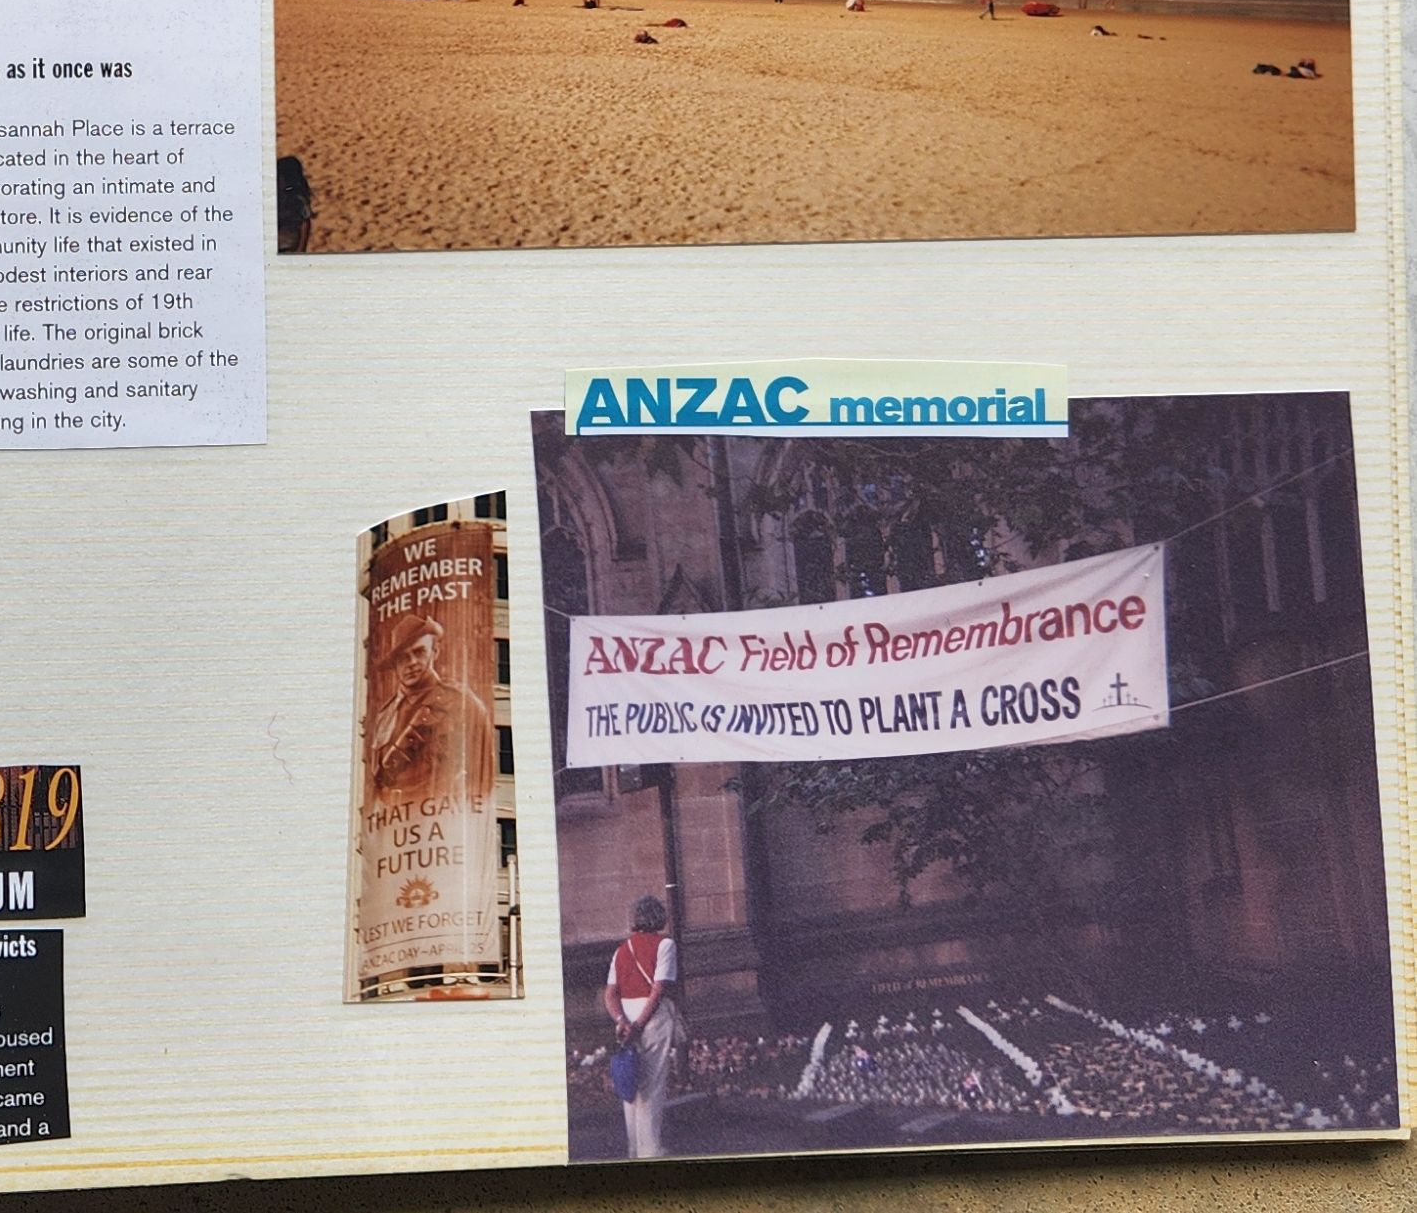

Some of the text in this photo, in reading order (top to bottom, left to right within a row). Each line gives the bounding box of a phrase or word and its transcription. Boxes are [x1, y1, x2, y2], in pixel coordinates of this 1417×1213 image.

[7, 64, 25, 78] as
[33, 58, 45, 78] it
[53, 63, 93, 78] once
[101, 63, 132, 77] was
[73, 119, 123, 136] Place
[132, 119, 145, 135] is
[152, 124, 163, 135] a
[170, 120, 235, 135] terrace
[54, 149, 69, 166] in
[76, 149, 105, 166] the
[113, 148, 159, 165] heart
[167, 148, 184, 164] of
[578, 376, 1045, 424] ANZAC memorial
[404, 538, 436, 563] WE
[371, 558, 482, 605] REMEMBER
[377, 581, 472, 622] THE PAST
[584, 595, 1146, 675] ANZAC Field of Remembrance
[586, 703, 621, 737] THE
[626, 702, 698, 734] PUBLIC
[726, 701, 819, 736] INVITED
[820, 699, 852, 735] TO
[859, 691, 942, 733] PLANT
[950, 689, 971, 729] A
[982, 676, 1081, 726] CROSS
[367, 801, 414, 833] THAT
[393, 822, 444, 848] US A
[377, 846, 464, 878] FUTURE
[364, 922, 389, 945] LEST
[391, 917, 414, 934] WE
